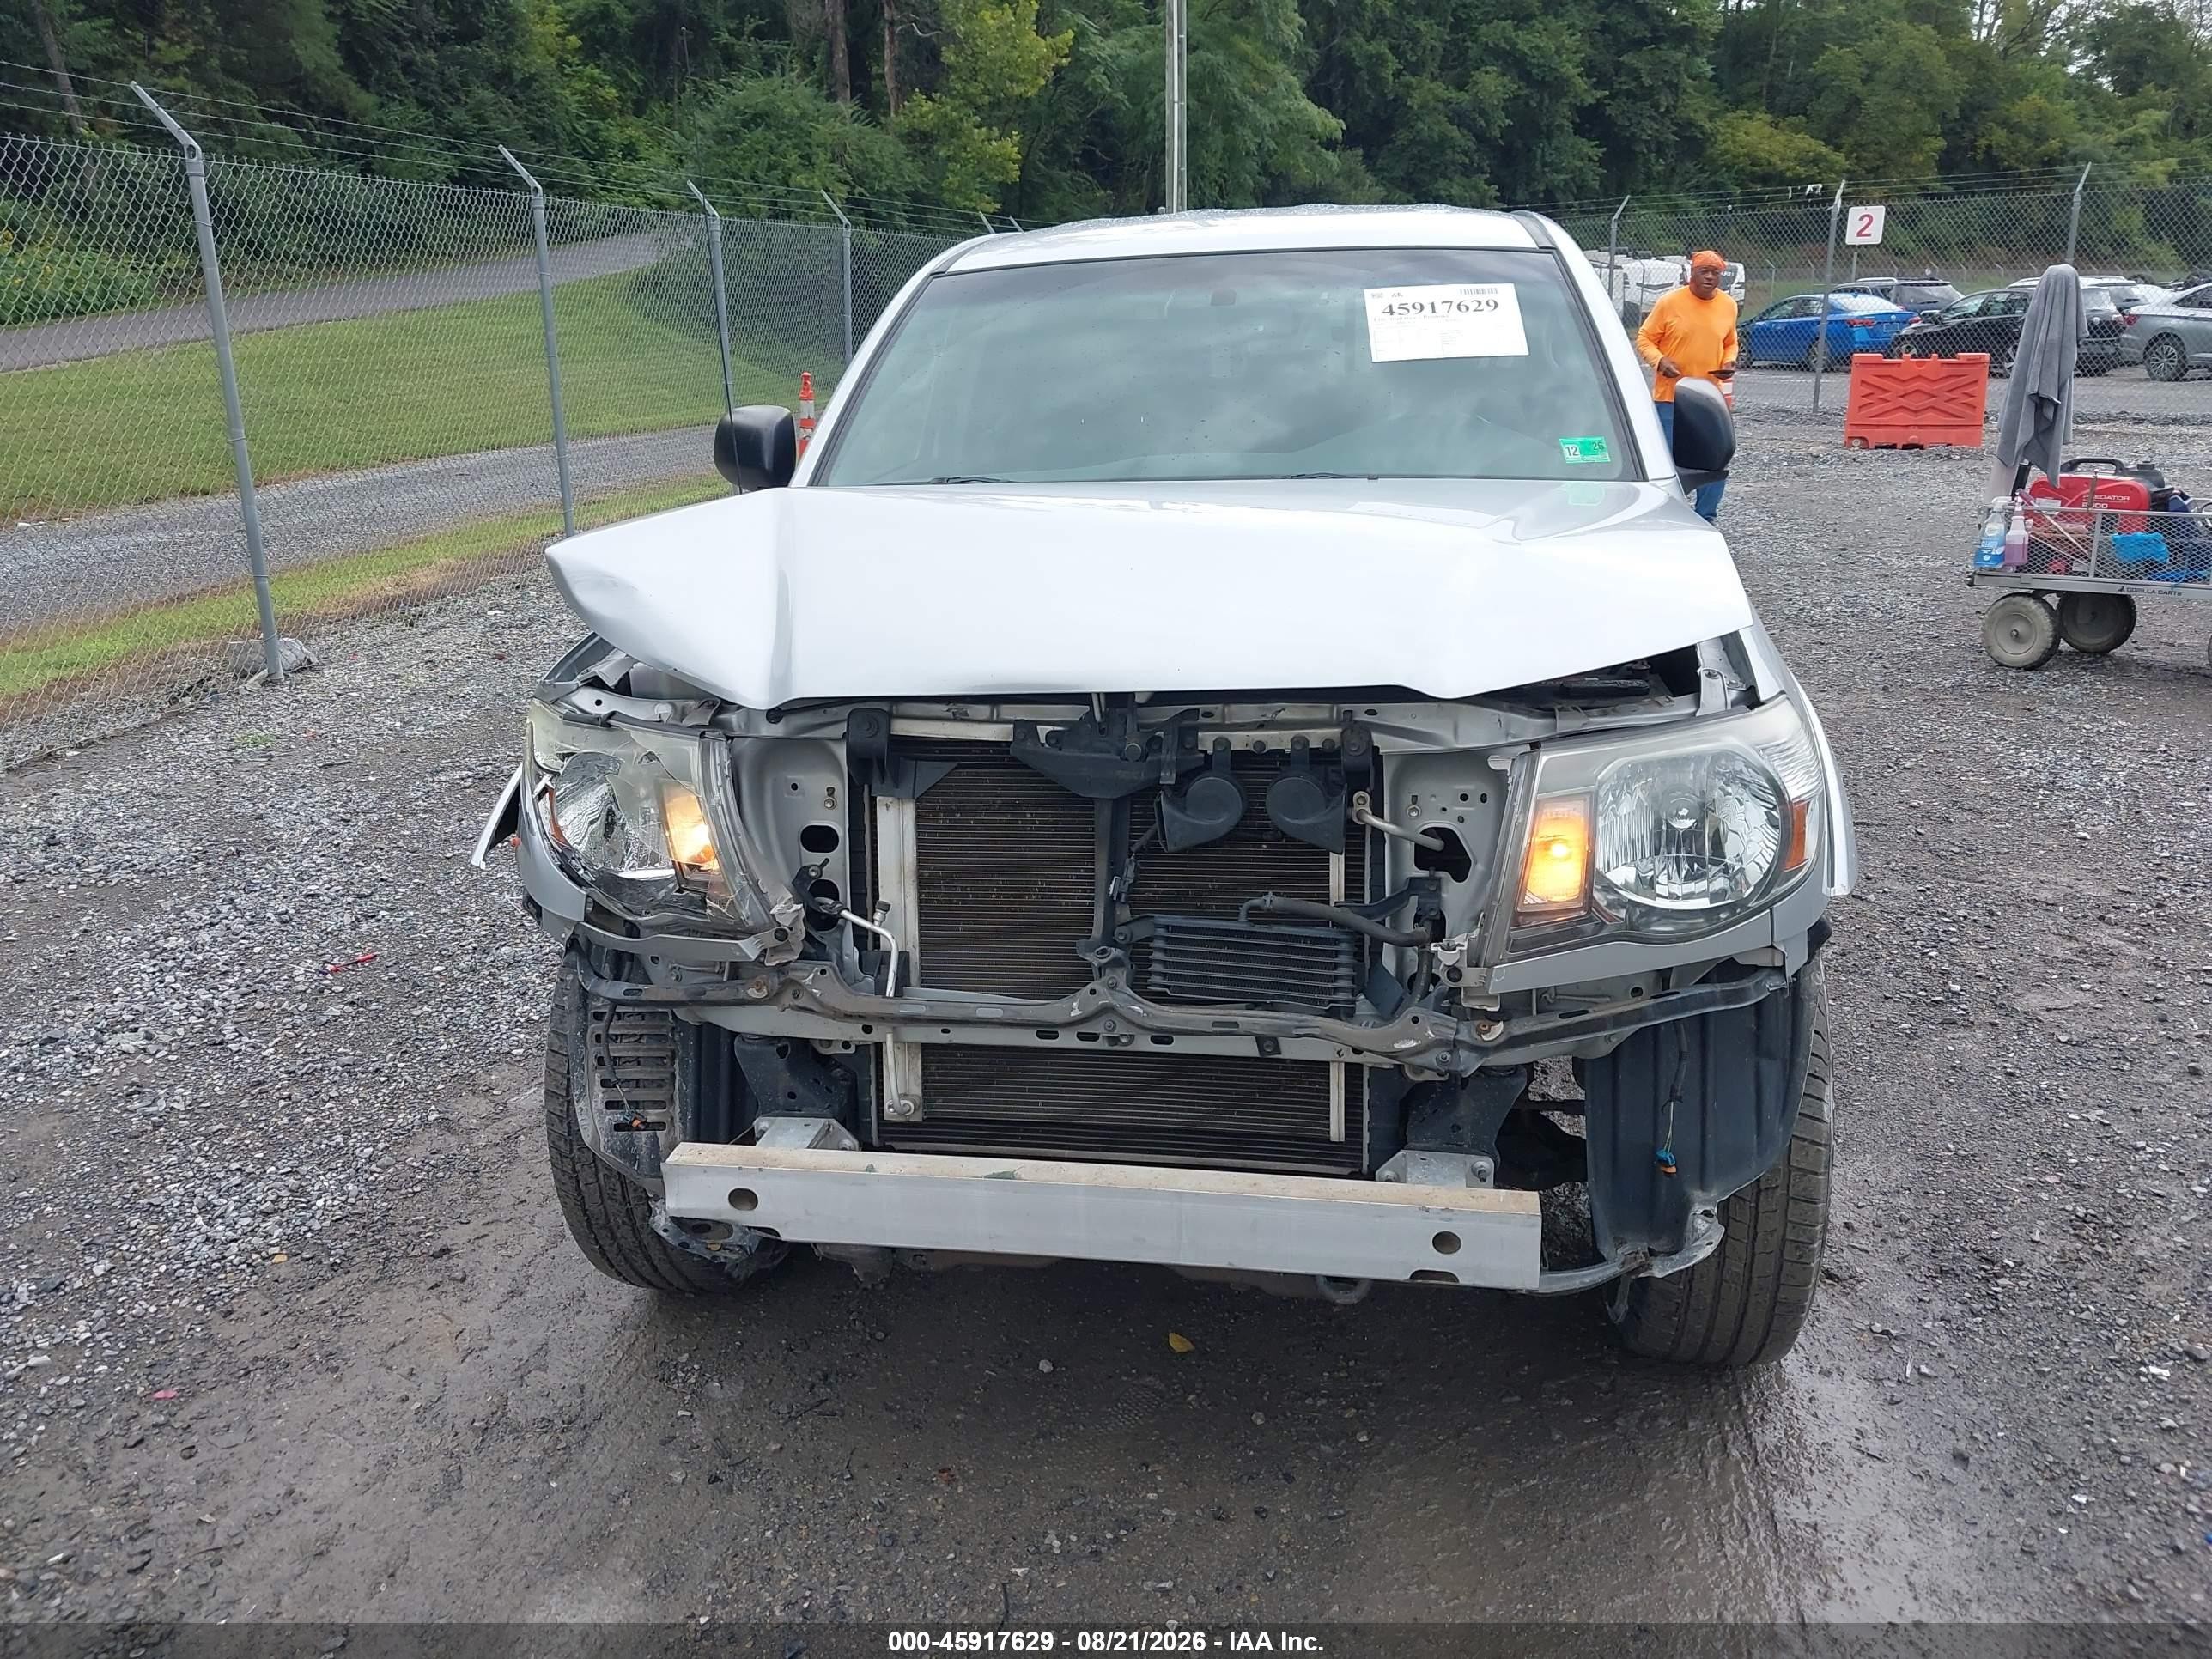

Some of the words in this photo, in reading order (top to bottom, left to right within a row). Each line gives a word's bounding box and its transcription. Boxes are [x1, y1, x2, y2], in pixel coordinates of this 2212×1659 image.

[1856, 214, 1874, 237] 2
[1382, 298, 1499, 316] 45917629
[1565, 446, 1580, 457] 12
